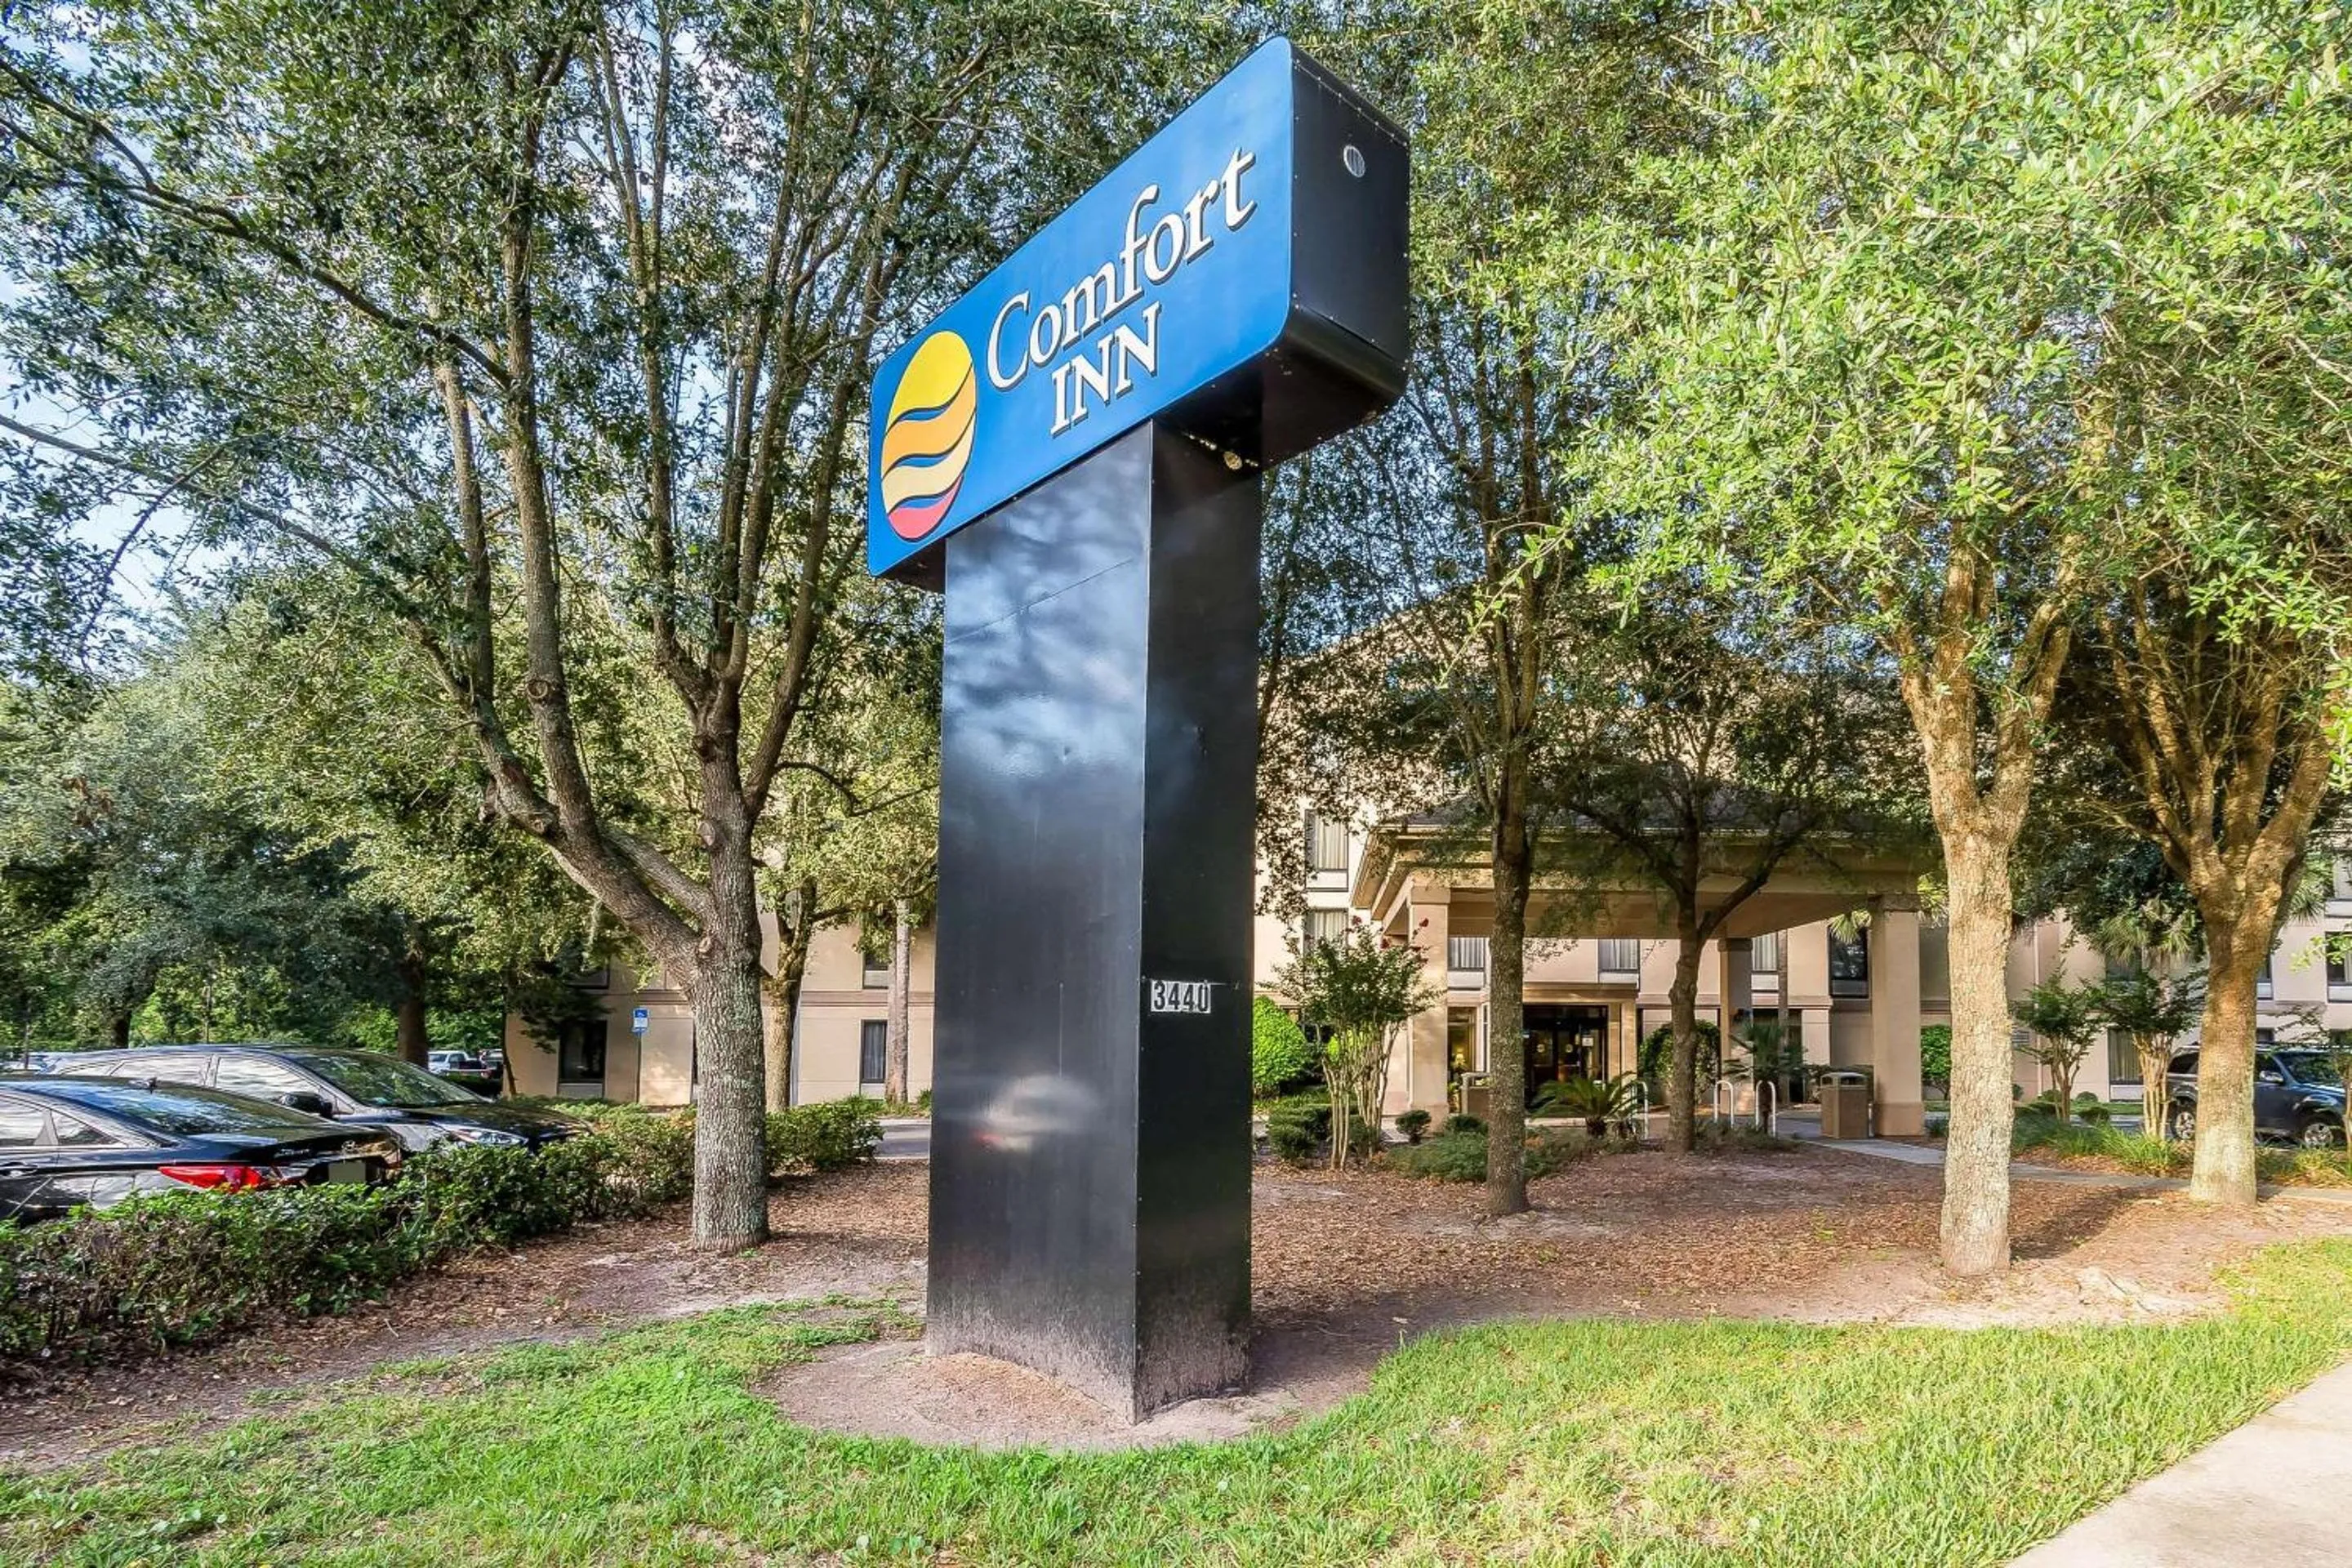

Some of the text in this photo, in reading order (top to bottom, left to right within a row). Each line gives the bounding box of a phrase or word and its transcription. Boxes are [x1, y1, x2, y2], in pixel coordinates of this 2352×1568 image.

[987, 147, 1257, 391] Comfort
[1049, 301, 1162, 438] INN
[1153, 981, 1209, 1012] 3440
